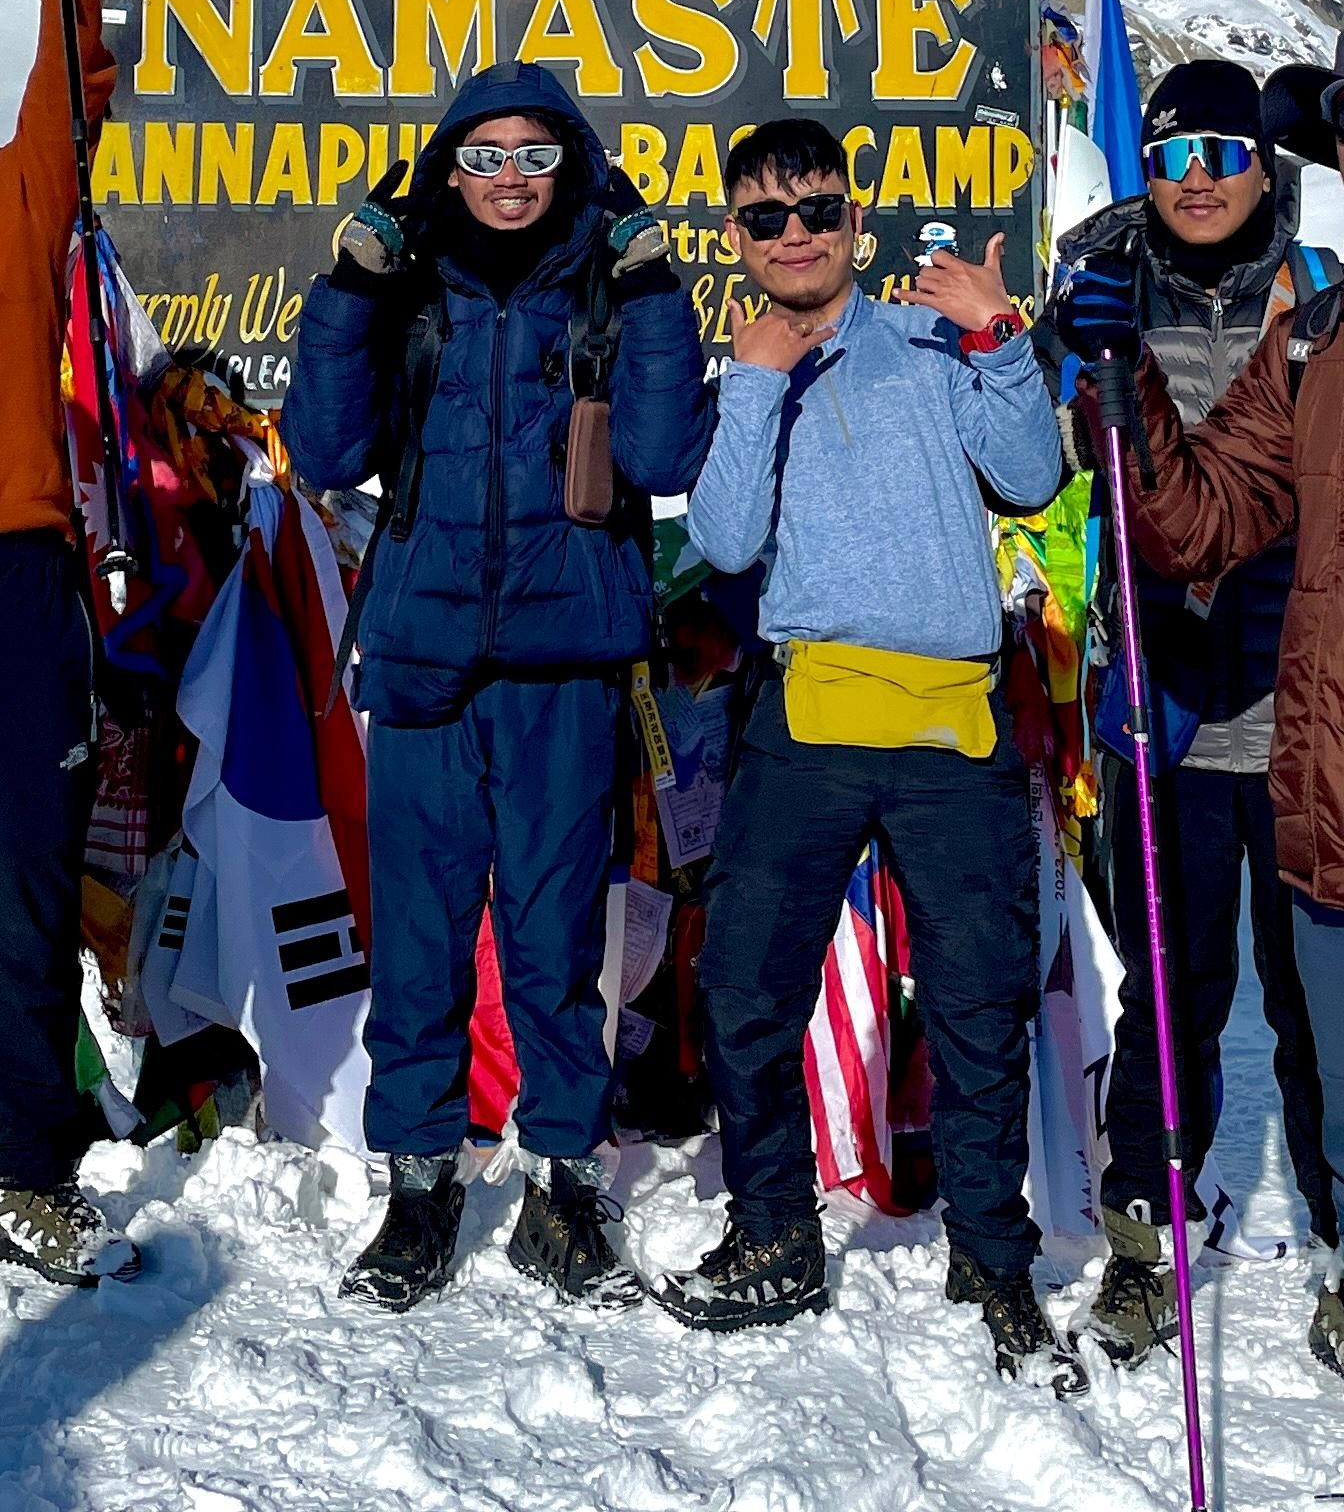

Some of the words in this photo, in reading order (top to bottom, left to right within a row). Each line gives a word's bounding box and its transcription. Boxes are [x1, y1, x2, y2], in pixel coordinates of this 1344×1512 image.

[91, 121, 439, 207] ANNAPU
[620, 121, 758, 209] BA
[842, 124, 1034, 209] CAMP
